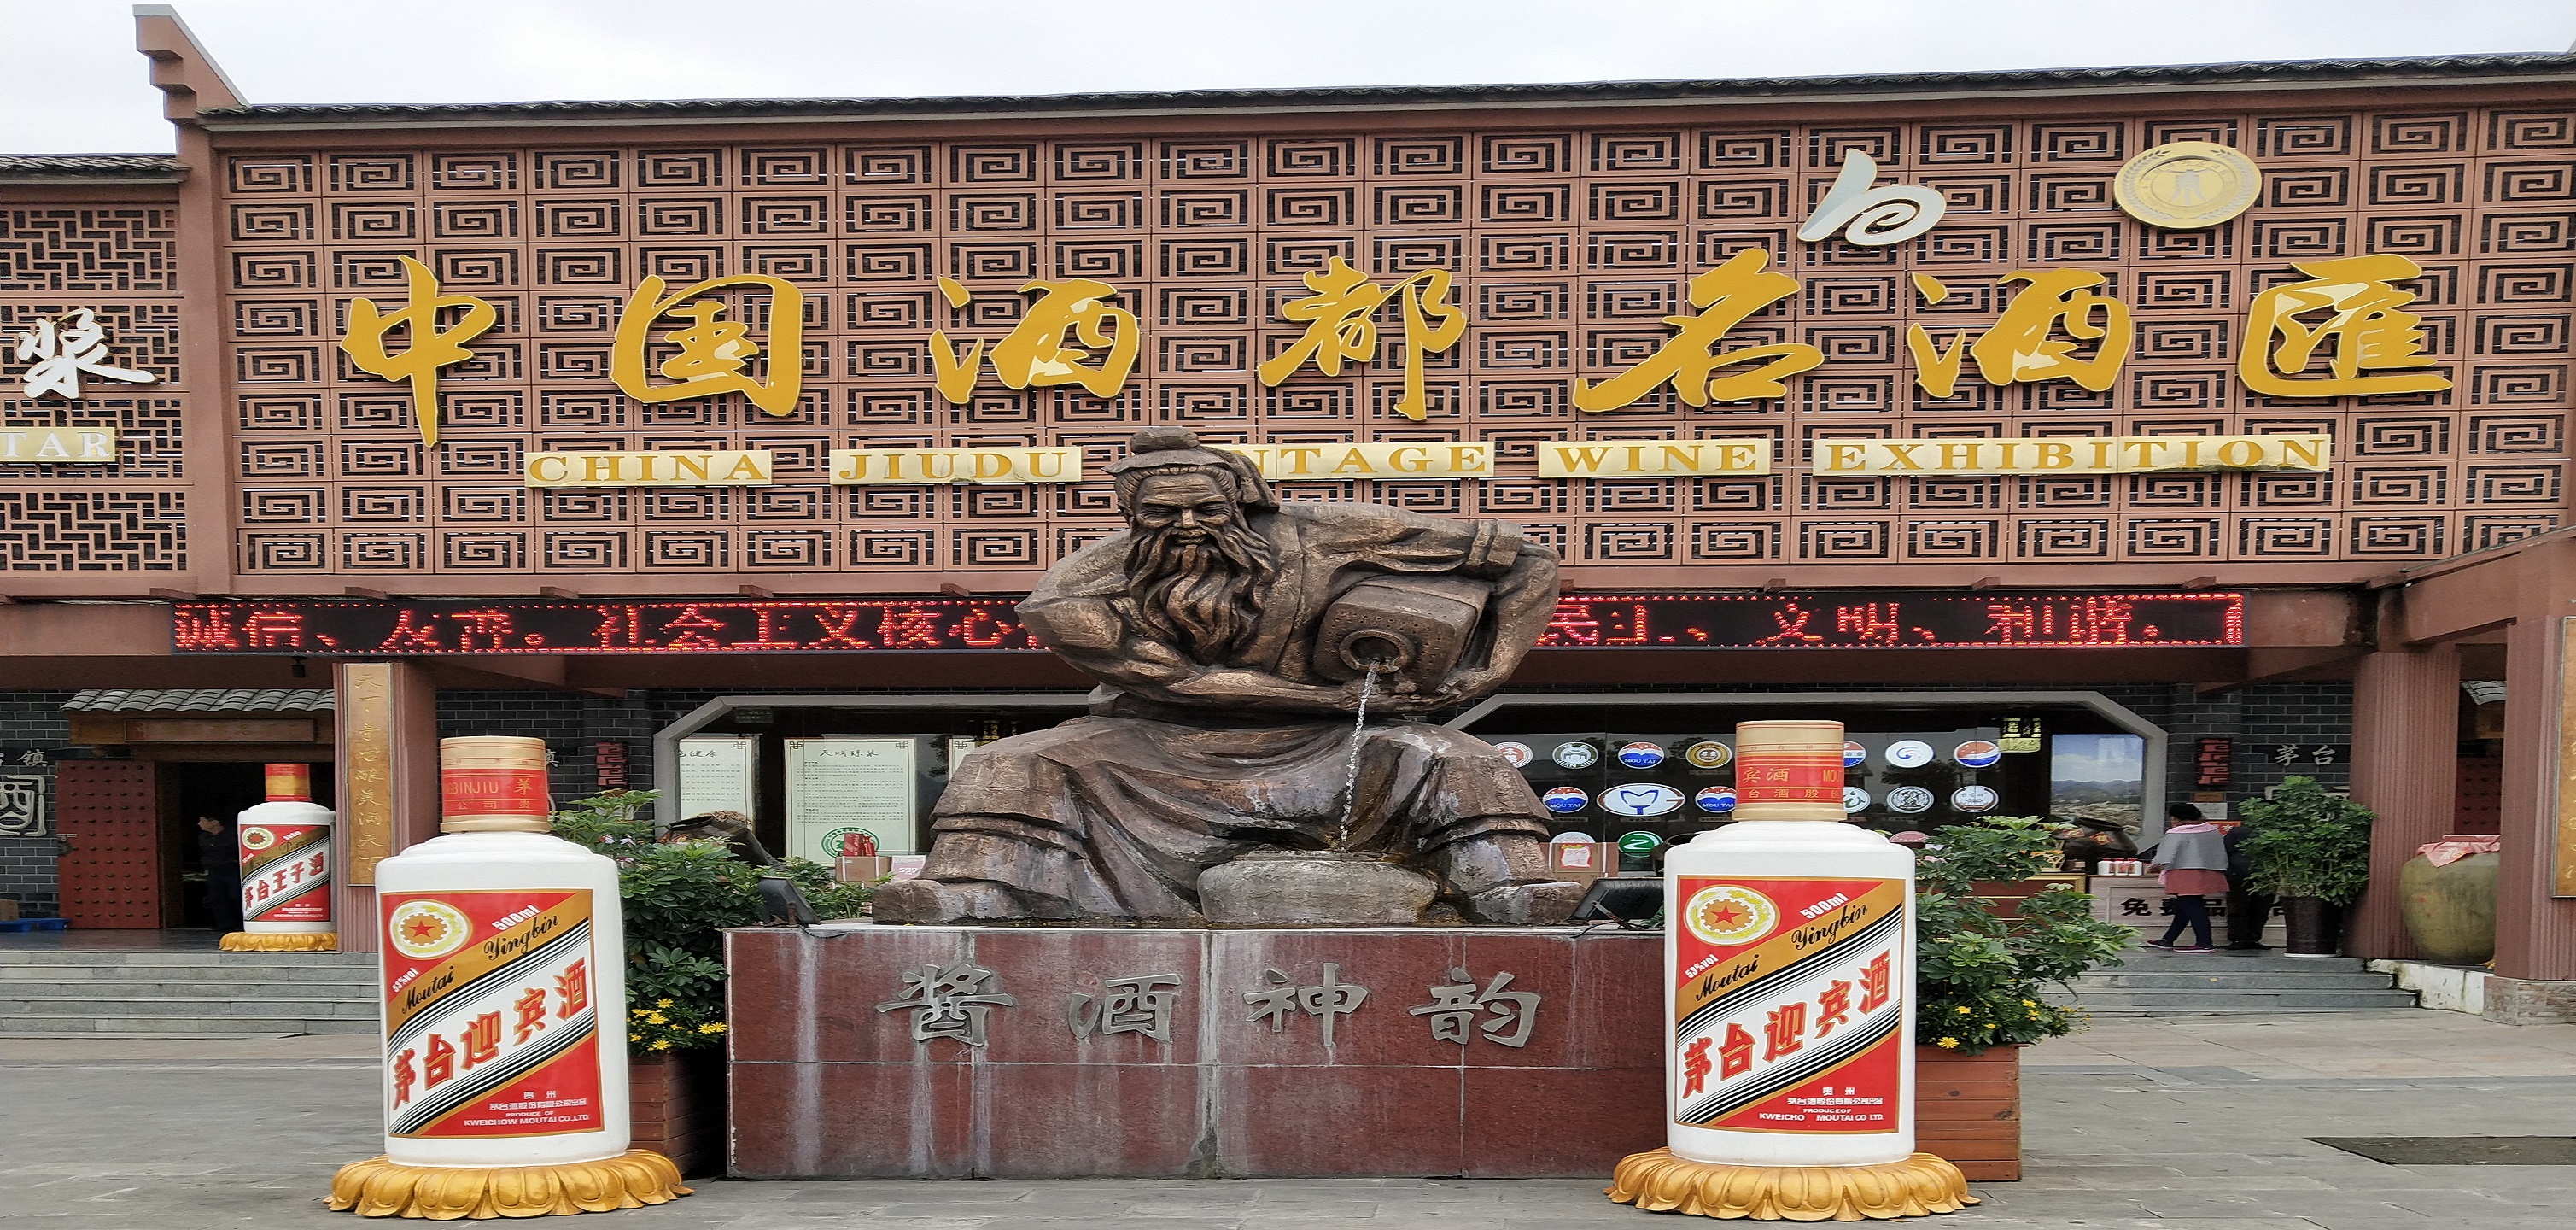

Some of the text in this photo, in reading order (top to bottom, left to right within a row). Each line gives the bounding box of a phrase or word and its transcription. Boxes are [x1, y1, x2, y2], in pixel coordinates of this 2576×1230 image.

[529, 454, 768, 482] CHINA
[838, 451, 1065, 481] JIUDU
[1549, 442, 1757, 474] WINE
[1825, 436, 2326, 473] EXHIBITION
[2275, 744, 2336, 766] 茅台
[245, 852, 324, 911] 茅台王子酒
[1799, 892, 1849, 920] 500ml
[491, 904, 540, 932] 500ml
[401, 913, 559, 1015] Moutai Yingbin
[1684, 953, 1719, 980] 53%vol
[1695, 901, 1868, 1001] Moutai Yingbin
[879, 962, 1542, 1049] 酱酒神韵
[1682, 948, 1892, 1100] 茅台迎宾酒
[393, 956, 587, 1111] 茅台迎宾酒
[1759, 1113, 1805, 1122] KWEICHO
